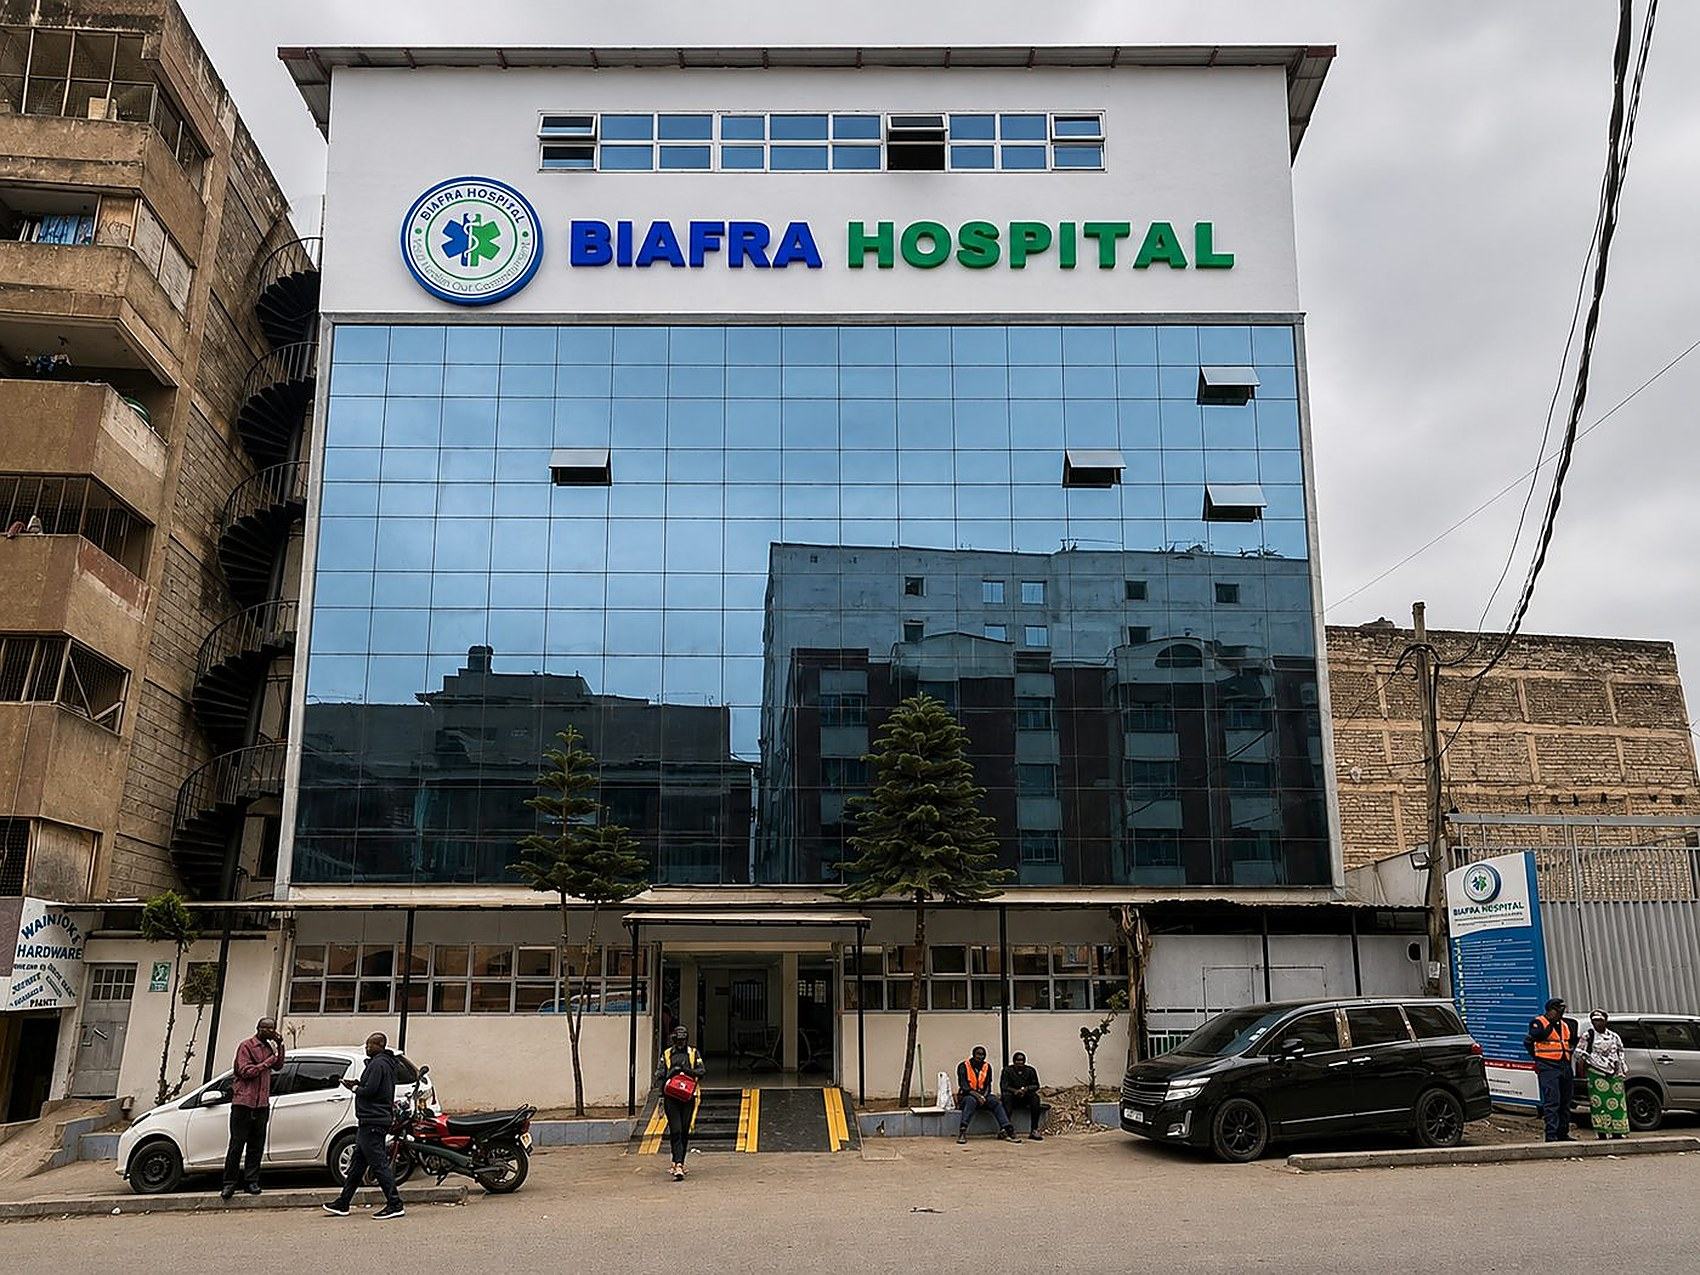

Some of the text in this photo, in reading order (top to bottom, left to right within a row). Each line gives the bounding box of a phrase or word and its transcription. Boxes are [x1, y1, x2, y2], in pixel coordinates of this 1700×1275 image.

[420, 188, 526, 224] BIAFRA HOSPITAL
[570, 220, 1235, 269] BIAFRA HOSPITAL
[1481, 901, 1525, 913] HOSPITAL
[16, 944, 83, 960] HARDWARE
